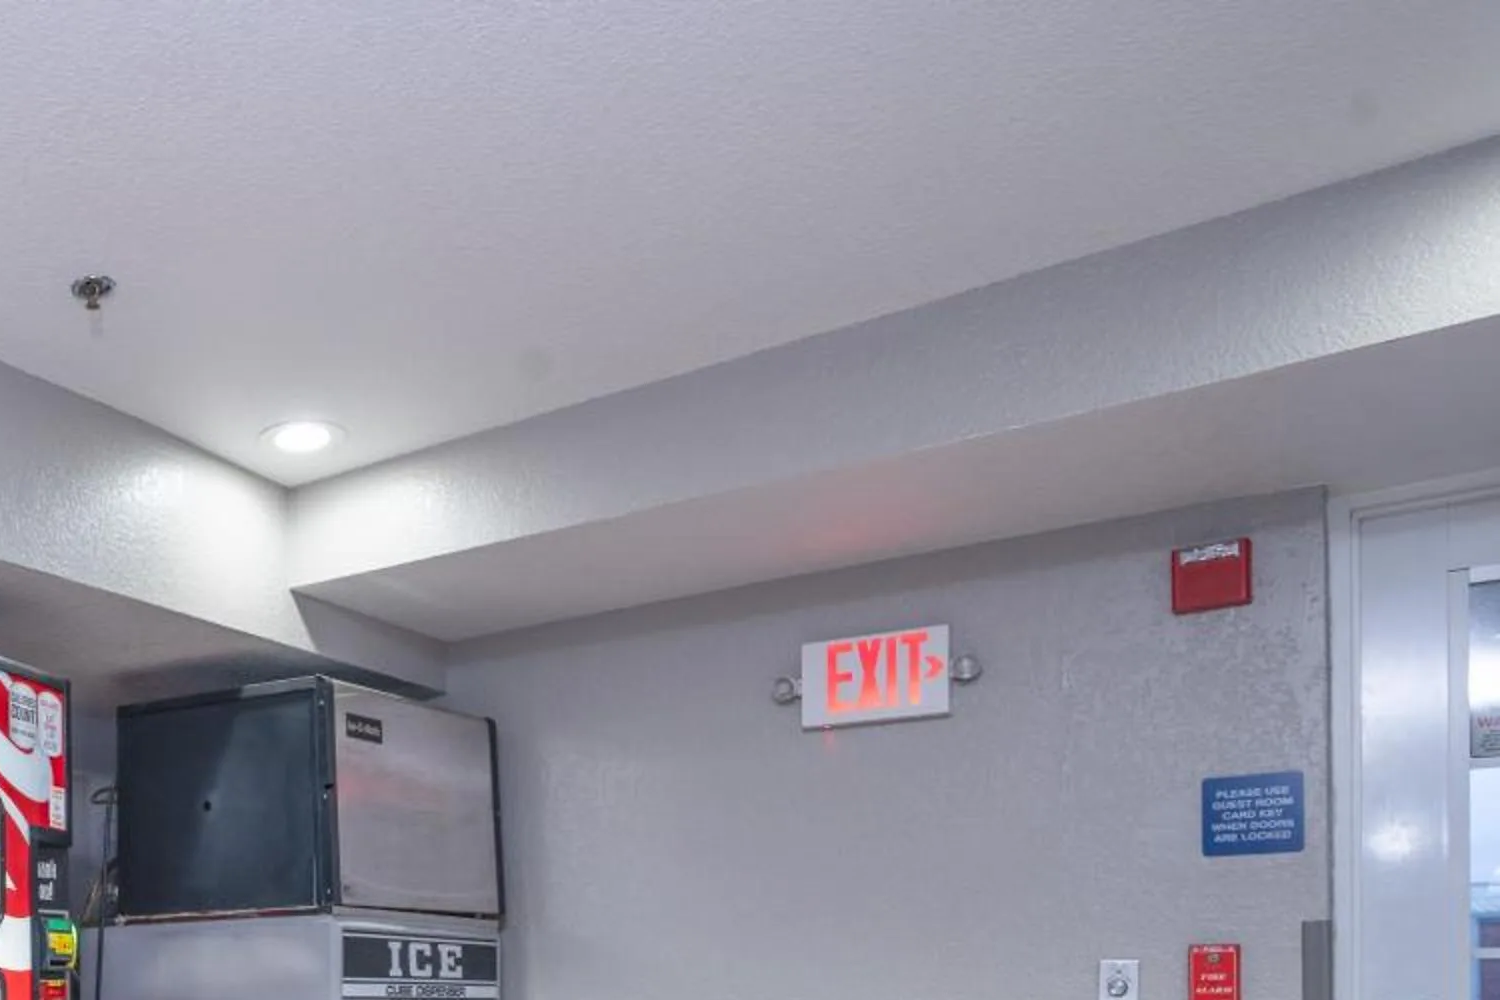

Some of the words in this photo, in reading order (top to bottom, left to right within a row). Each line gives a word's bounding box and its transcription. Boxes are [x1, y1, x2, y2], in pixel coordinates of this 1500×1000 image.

[826, 630, 928, 713] EXIT
[388, 941, 463, 978] ICE
[1200, 972, 1228, 982] FIRE
